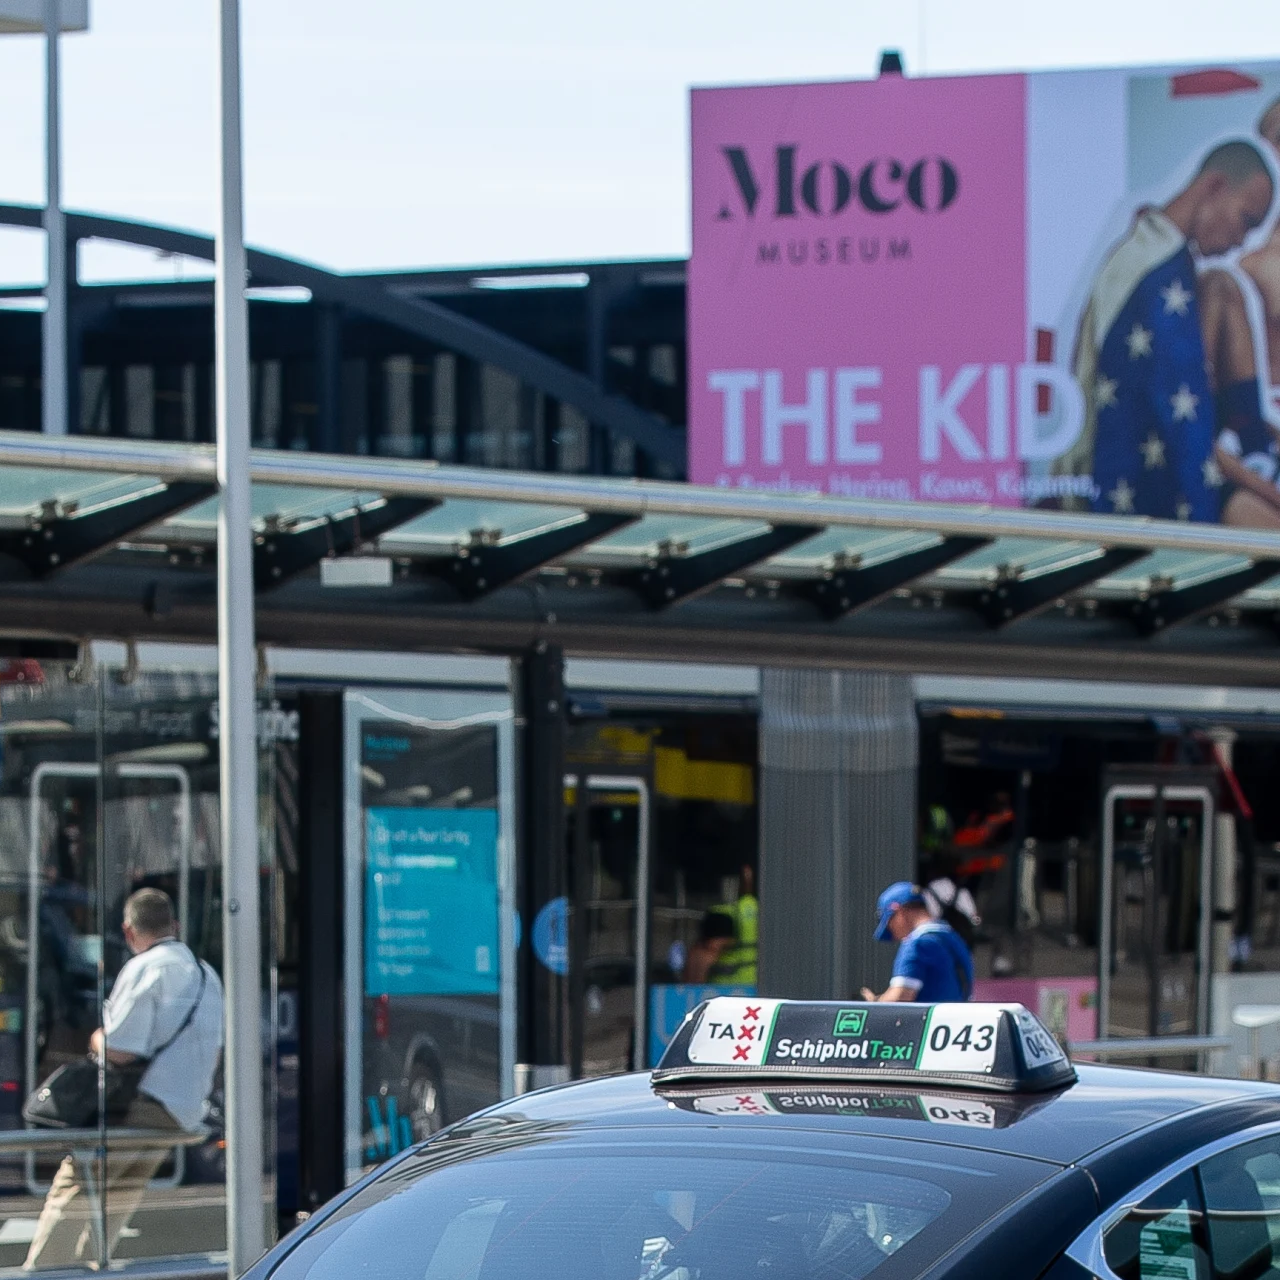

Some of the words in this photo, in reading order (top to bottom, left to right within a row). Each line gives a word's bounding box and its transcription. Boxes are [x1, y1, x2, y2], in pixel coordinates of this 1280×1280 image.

[715, 143, 960, 218] Moco
[756, 236, 912, 265] MUSEUM
[708, 367, 883, 466] THE
[919, 363, 1087, 461] KID
[709, 1022, 765, 1041] TAXI
[929, 1024, 995, 1052] 043
[775, 1038, 914, 1062] SchipholTaxi
